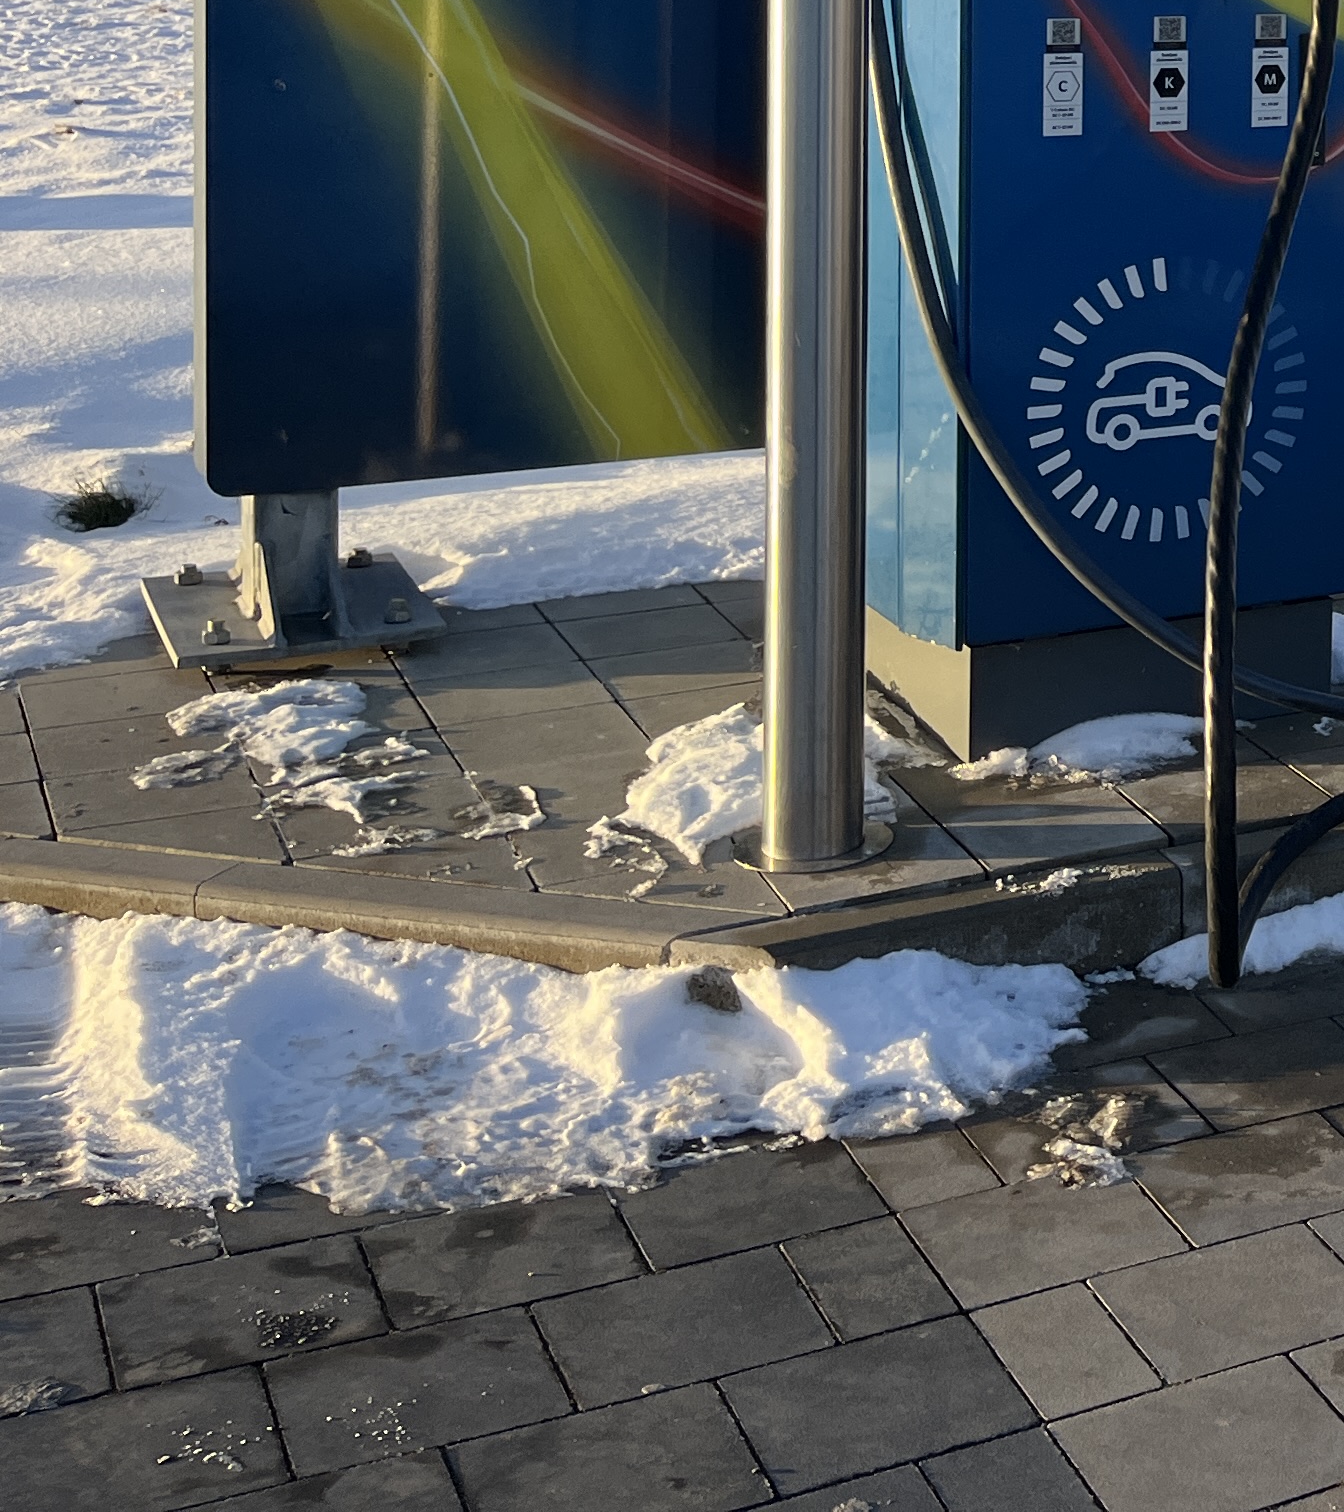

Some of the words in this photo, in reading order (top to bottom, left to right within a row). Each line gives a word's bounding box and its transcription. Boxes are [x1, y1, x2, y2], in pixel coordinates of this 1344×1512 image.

[1164, 76, 1175, 89] K
[1264, 73, 1277, 85] M
[1058, 80, 1069, 93] C
